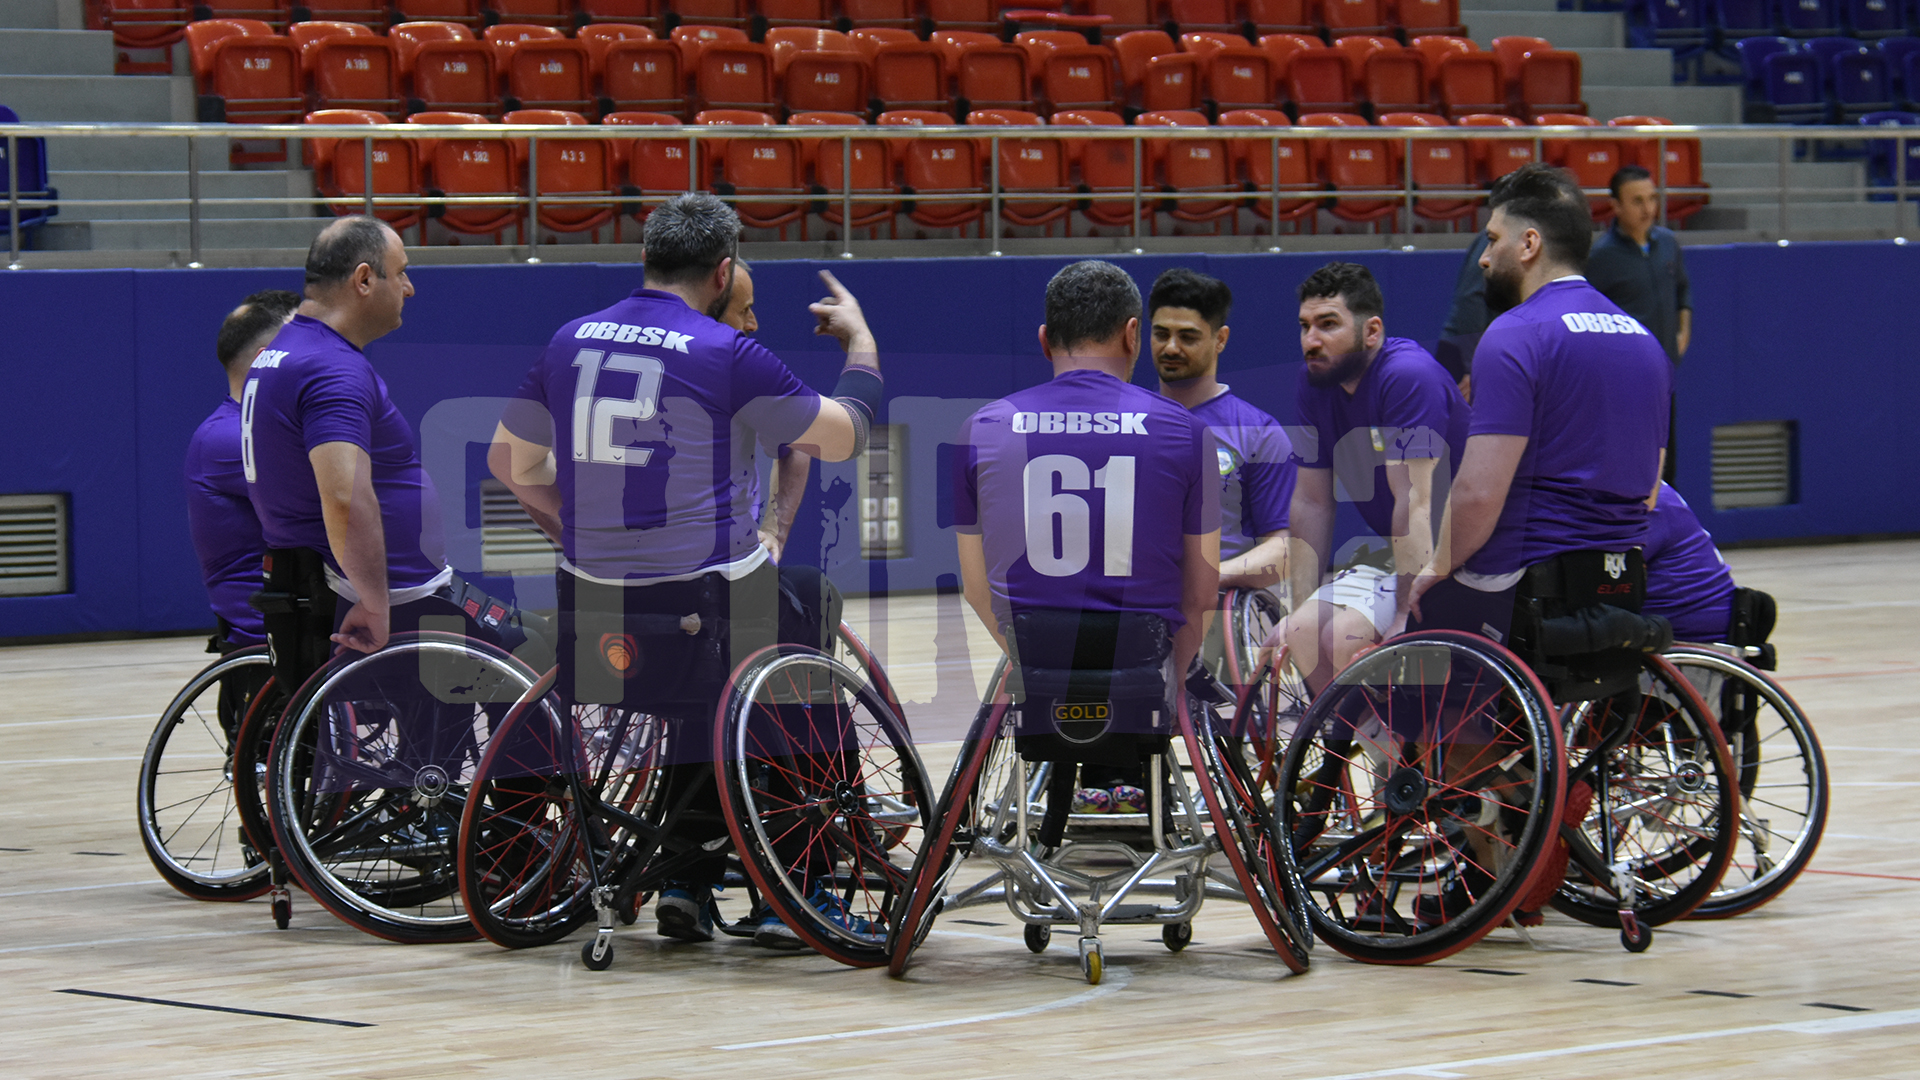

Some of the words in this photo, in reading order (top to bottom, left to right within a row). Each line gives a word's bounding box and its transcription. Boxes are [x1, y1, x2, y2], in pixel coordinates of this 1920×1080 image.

[574, 321, 695, 354] OBBSK
[241, 378, 259, 483] 8
[571, 348, 665, 468] 12
[1012, 411, 1149, 435] OBBSK
[1023, 454, 1136, 577] 61
[1055, 705, 1109, 719] GOLD
